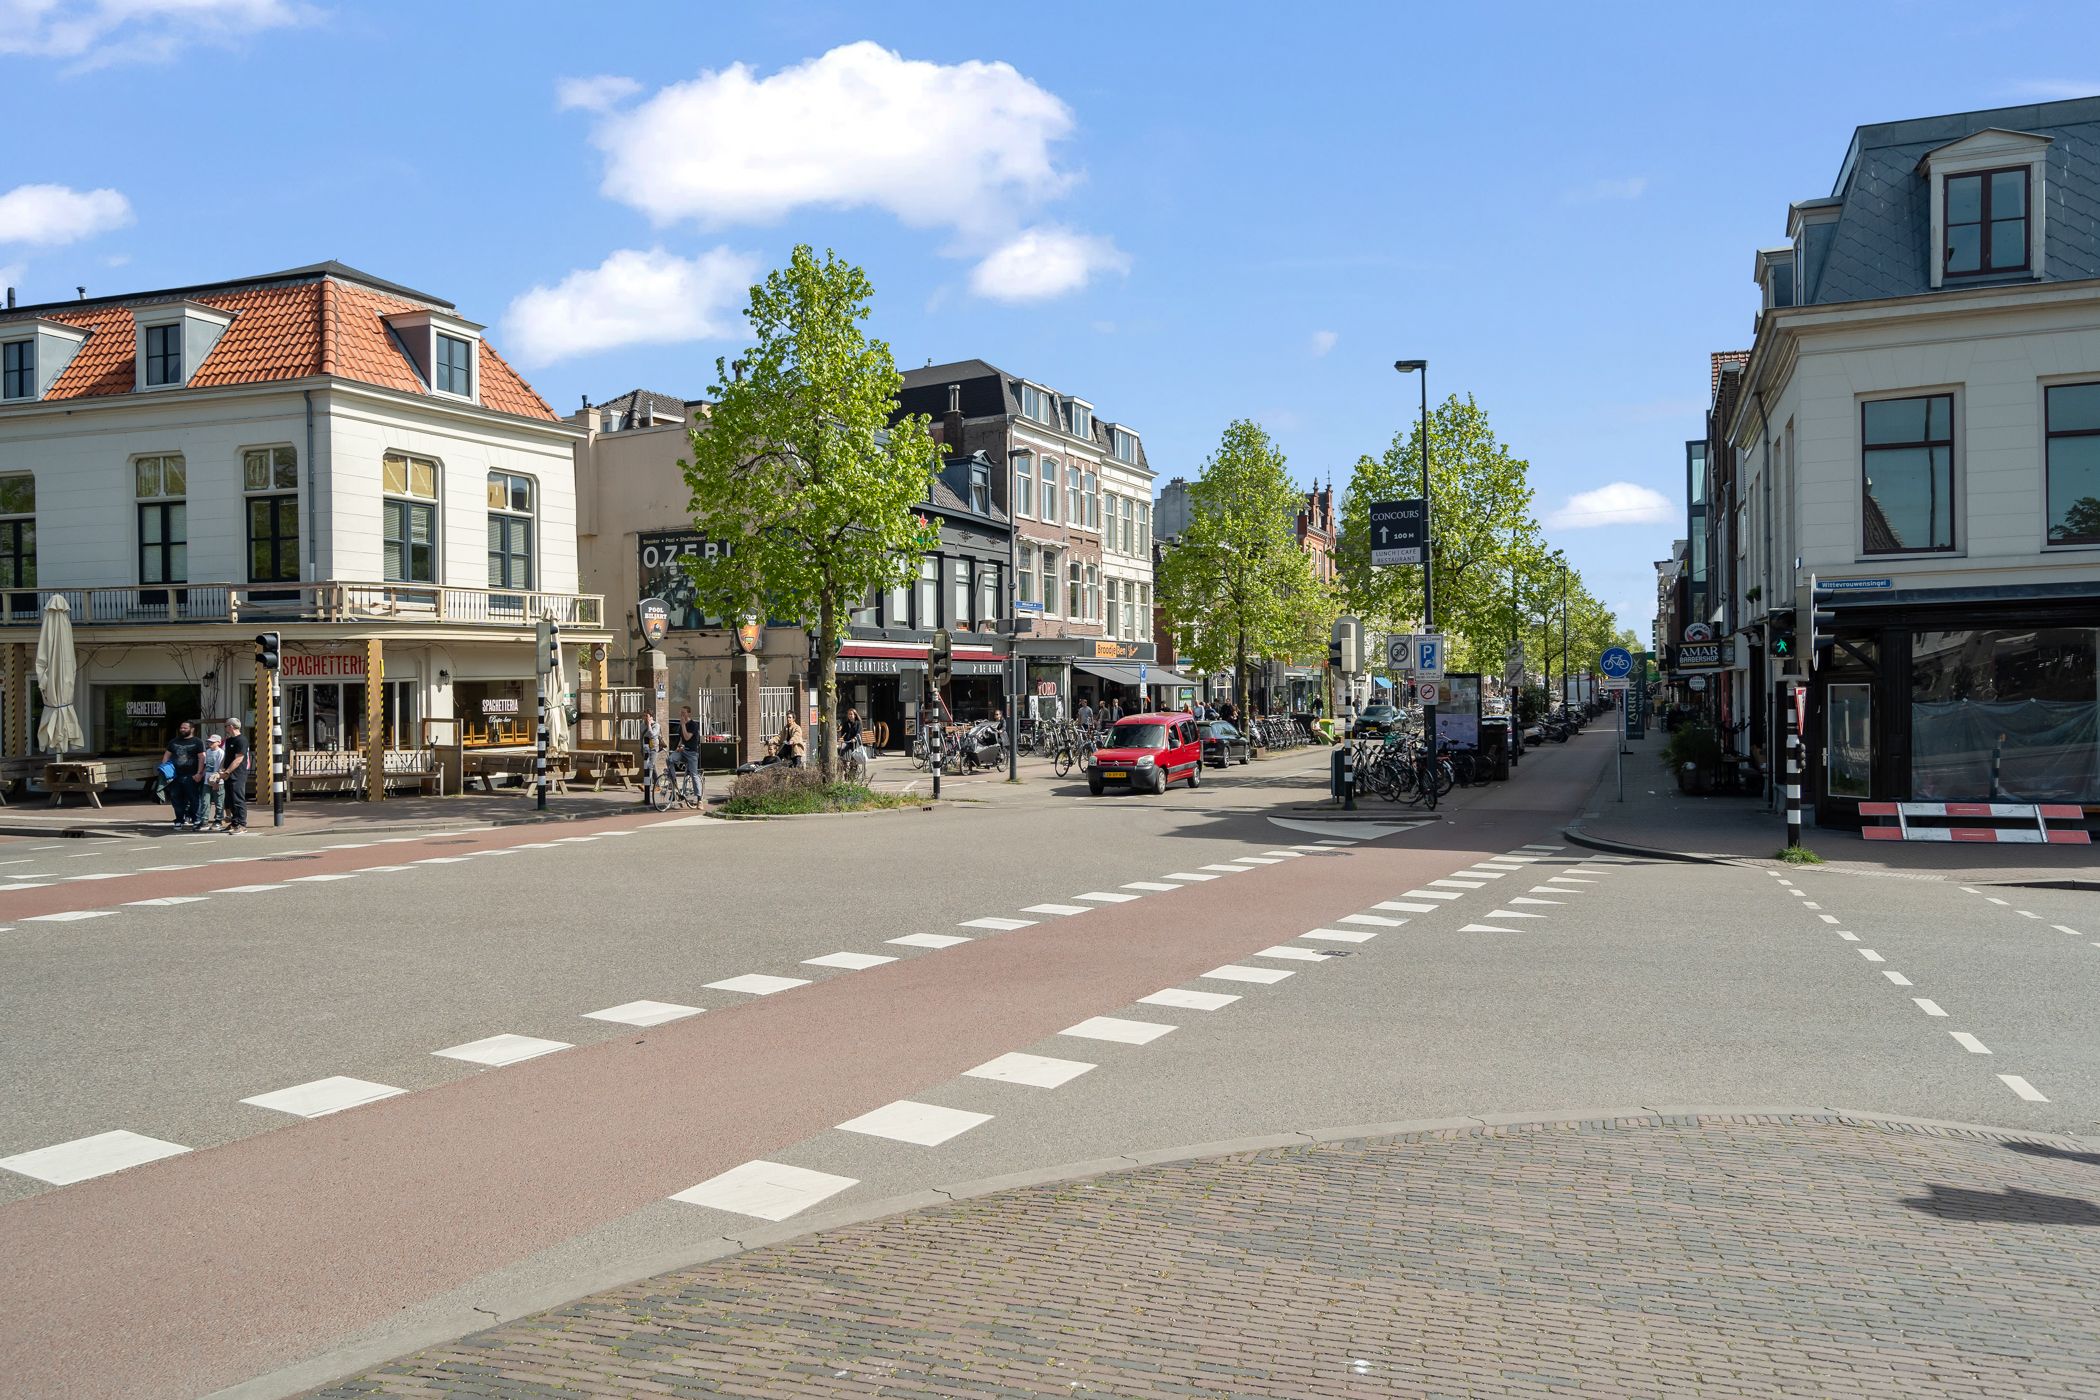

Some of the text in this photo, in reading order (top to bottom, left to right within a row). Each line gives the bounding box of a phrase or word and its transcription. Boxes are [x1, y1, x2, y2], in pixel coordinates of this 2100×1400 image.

[1372, 510, 1419, 521] CONCOURS
[1098, 644, 1116, 657] Broodje
[1394, 648, 1406, 656] 30
[1680, 646, 1718, 656] AMAR
[1680, 655, 1719, 664] BARBERSHOP
[842, 662, 850, 672] DE
[126, 701, 166, 715] SPAGHETTERIA
[482, 699, 518, 712] SPAGHETTERIA
